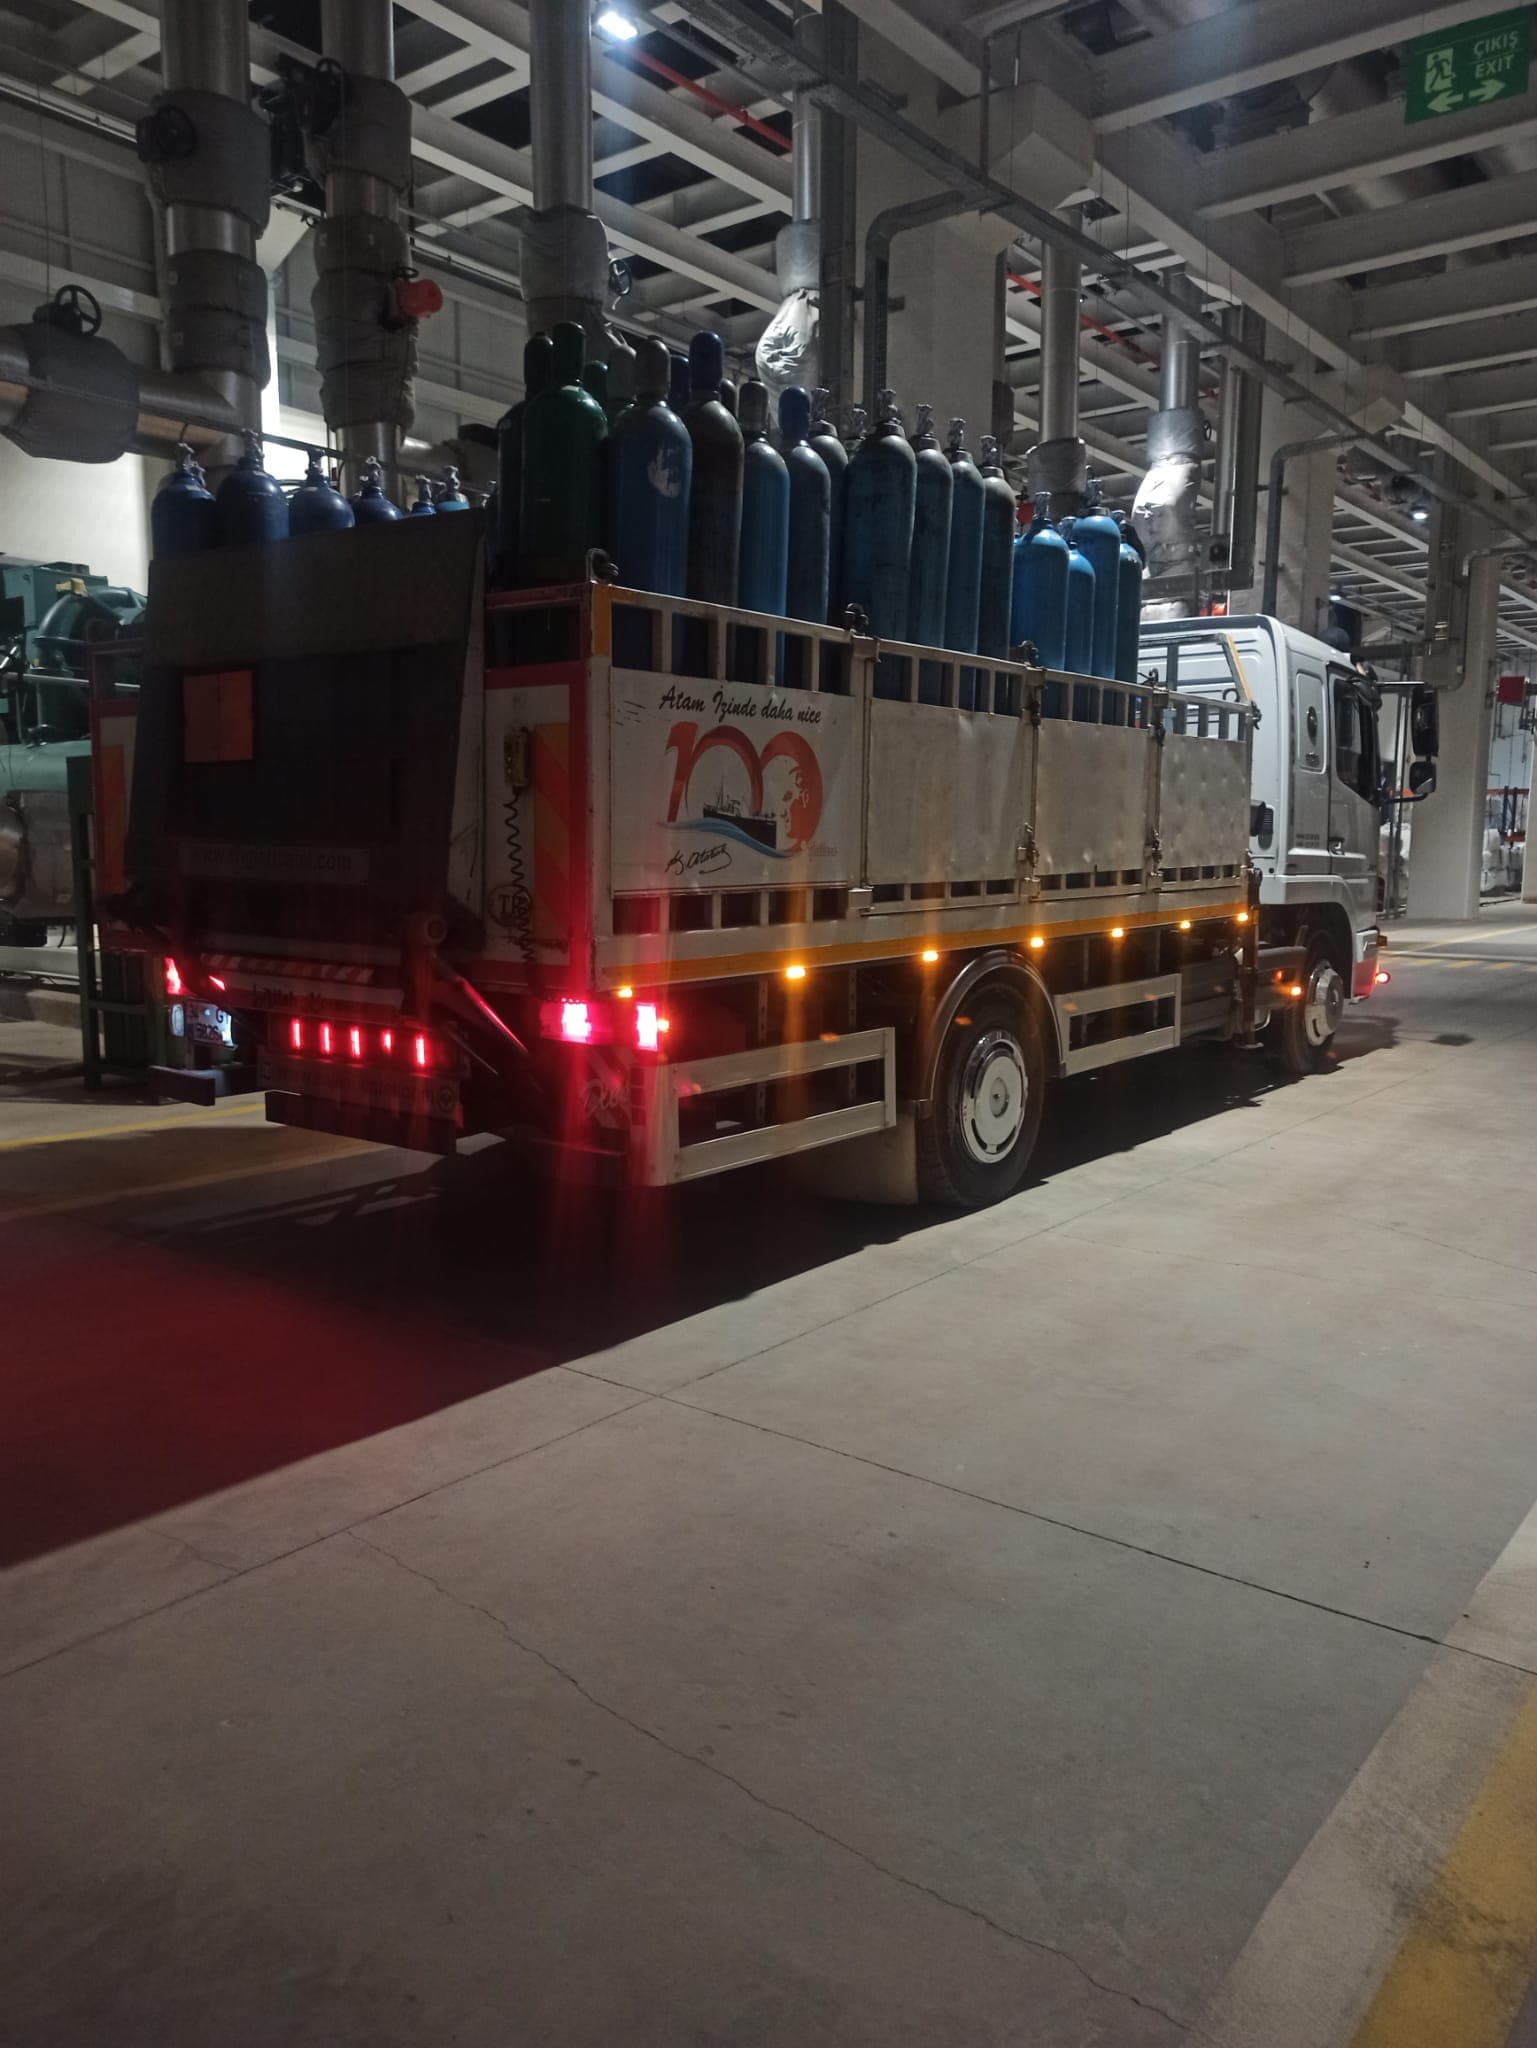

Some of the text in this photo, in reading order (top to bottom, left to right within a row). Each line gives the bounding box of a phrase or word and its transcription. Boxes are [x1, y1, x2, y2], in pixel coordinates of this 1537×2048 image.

[1474, 31, 1519, 59] ÇIKIŞ
[1475, 54, 1515, 79] EXIT
[659, 685, 822, 724] Atam İzinde daha nice
[665, 721, 824, 854] 100
